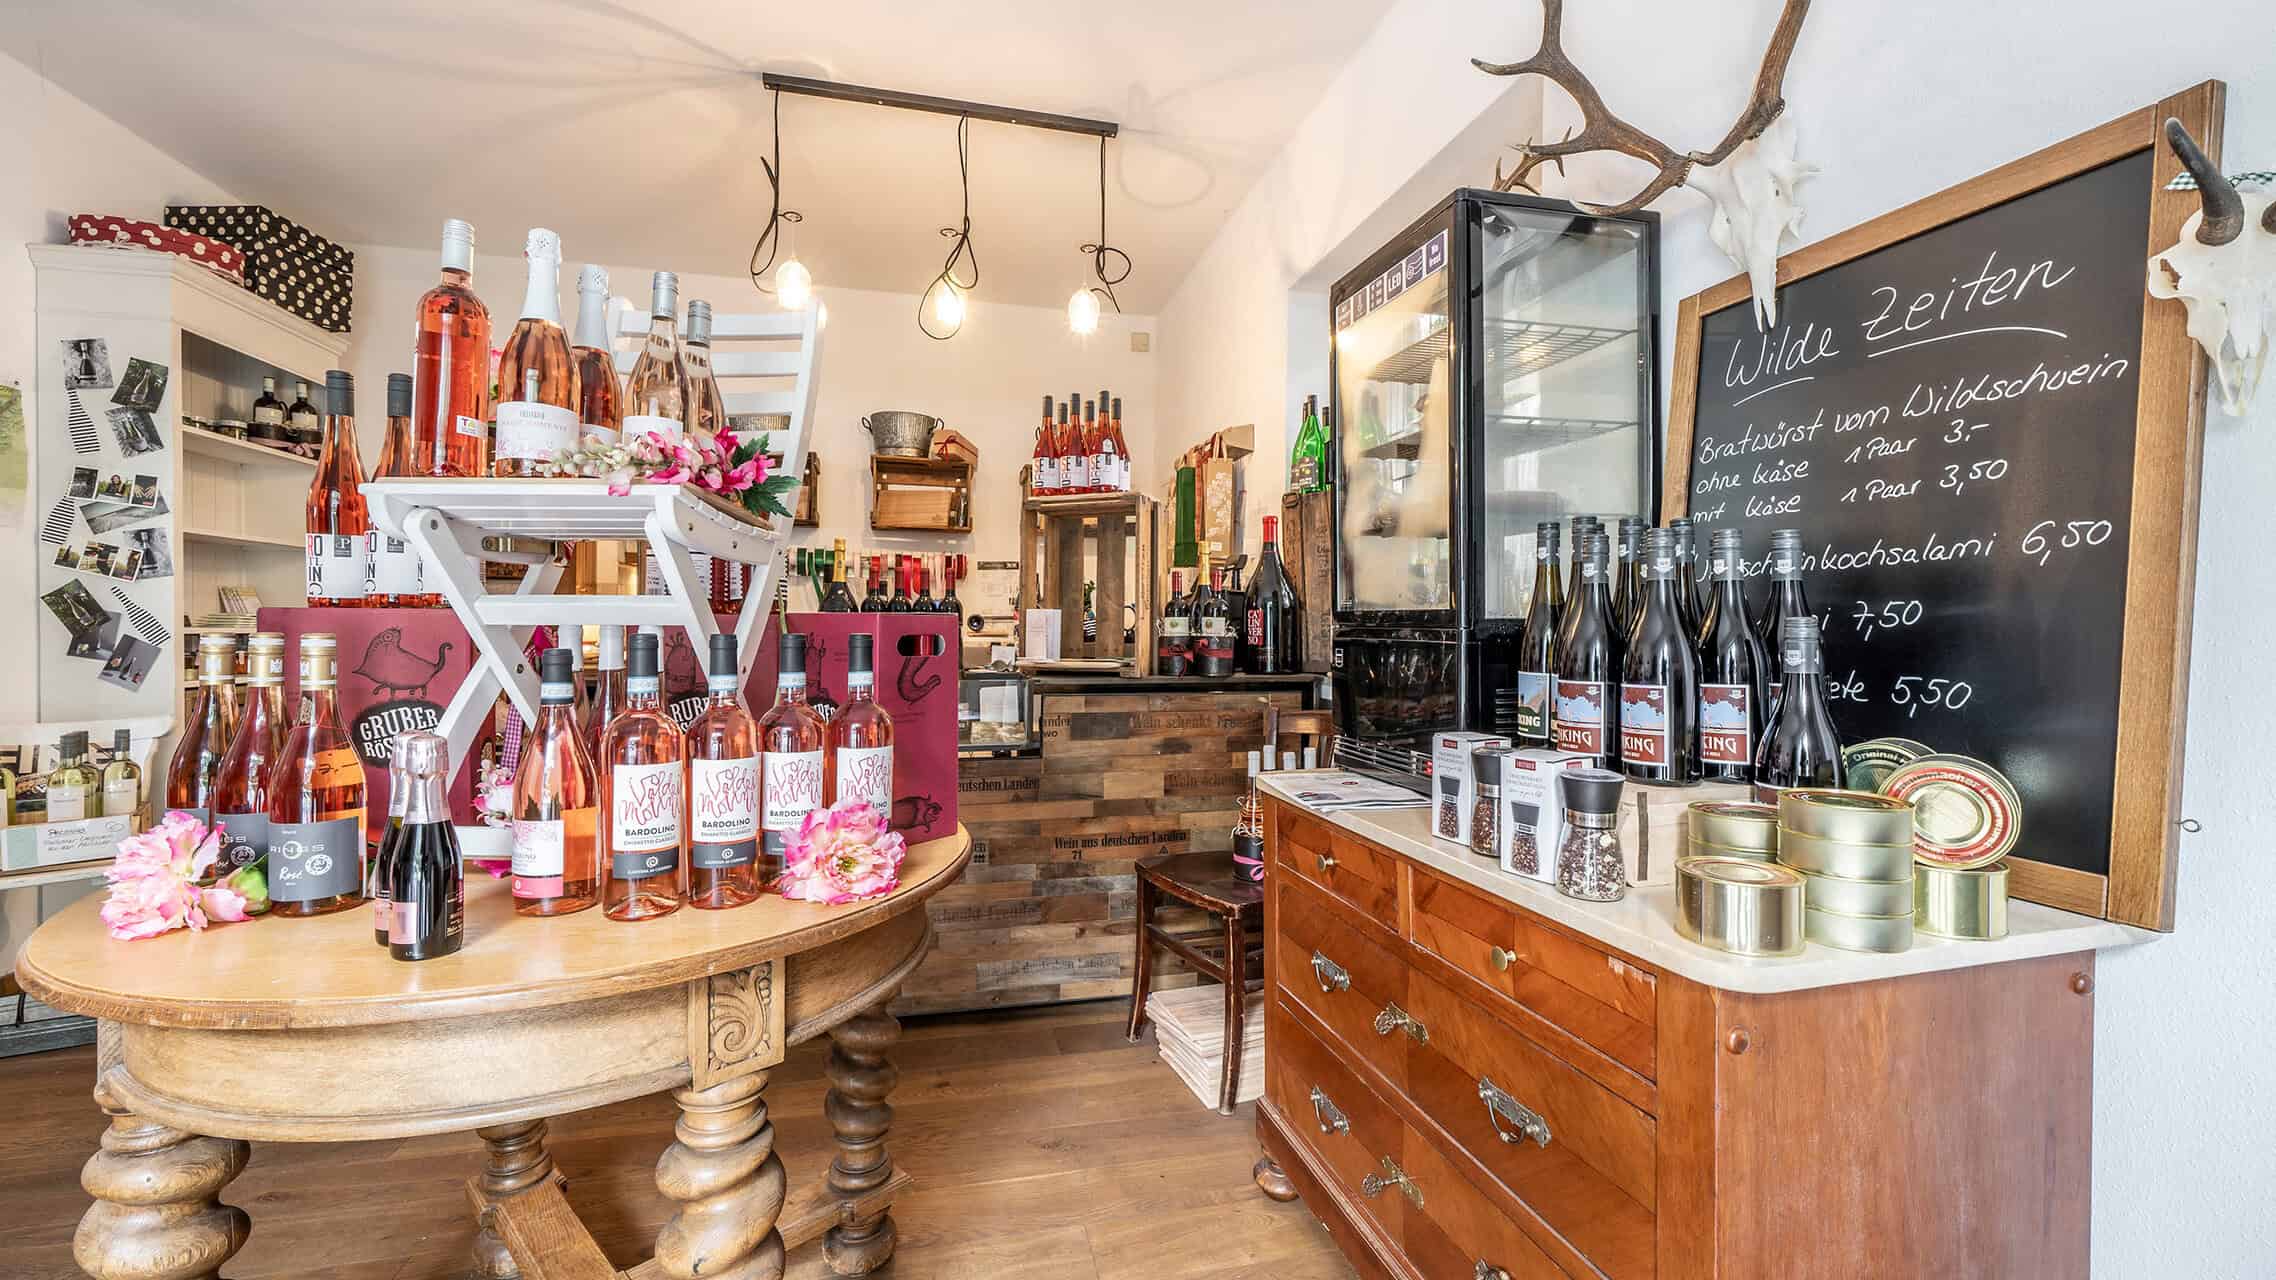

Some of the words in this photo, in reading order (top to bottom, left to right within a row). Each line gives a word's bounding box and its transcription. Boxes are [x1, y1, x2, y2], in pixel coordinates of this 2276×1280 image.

[1388, 272, 1402, 292] LED
[1725, 323, 1840, 388] Wilde
[1861, 250, 2076, 341] Zeiten
[1834, 405, 1890, 433] vom
[1696, 472, 1742, 494] ohne
[1866, 436, 1918, 460] Paar
[1693, 502, 1726, 524] mit
[1865, 479, 1921, 501] Paar
[1939, 459, 2008, 496] 3,50
[2021, 520, 2113, 567] 6,50
[1852, 600, 1924, 642] 7,50
[1891, 675, 1973, 718] 5,50
[359, 706, 438, 740] GRUBER
[1518, 713, 1541, 727] KING
[1624, 736, 1654, 756] KING
[1703, 736, 1736, 755] KING
[625, 824, 676, 837] BARDOLINO
[701, 817, 751, 828] BARDOLINO
[1055, 836, 1078, 849] Wein
